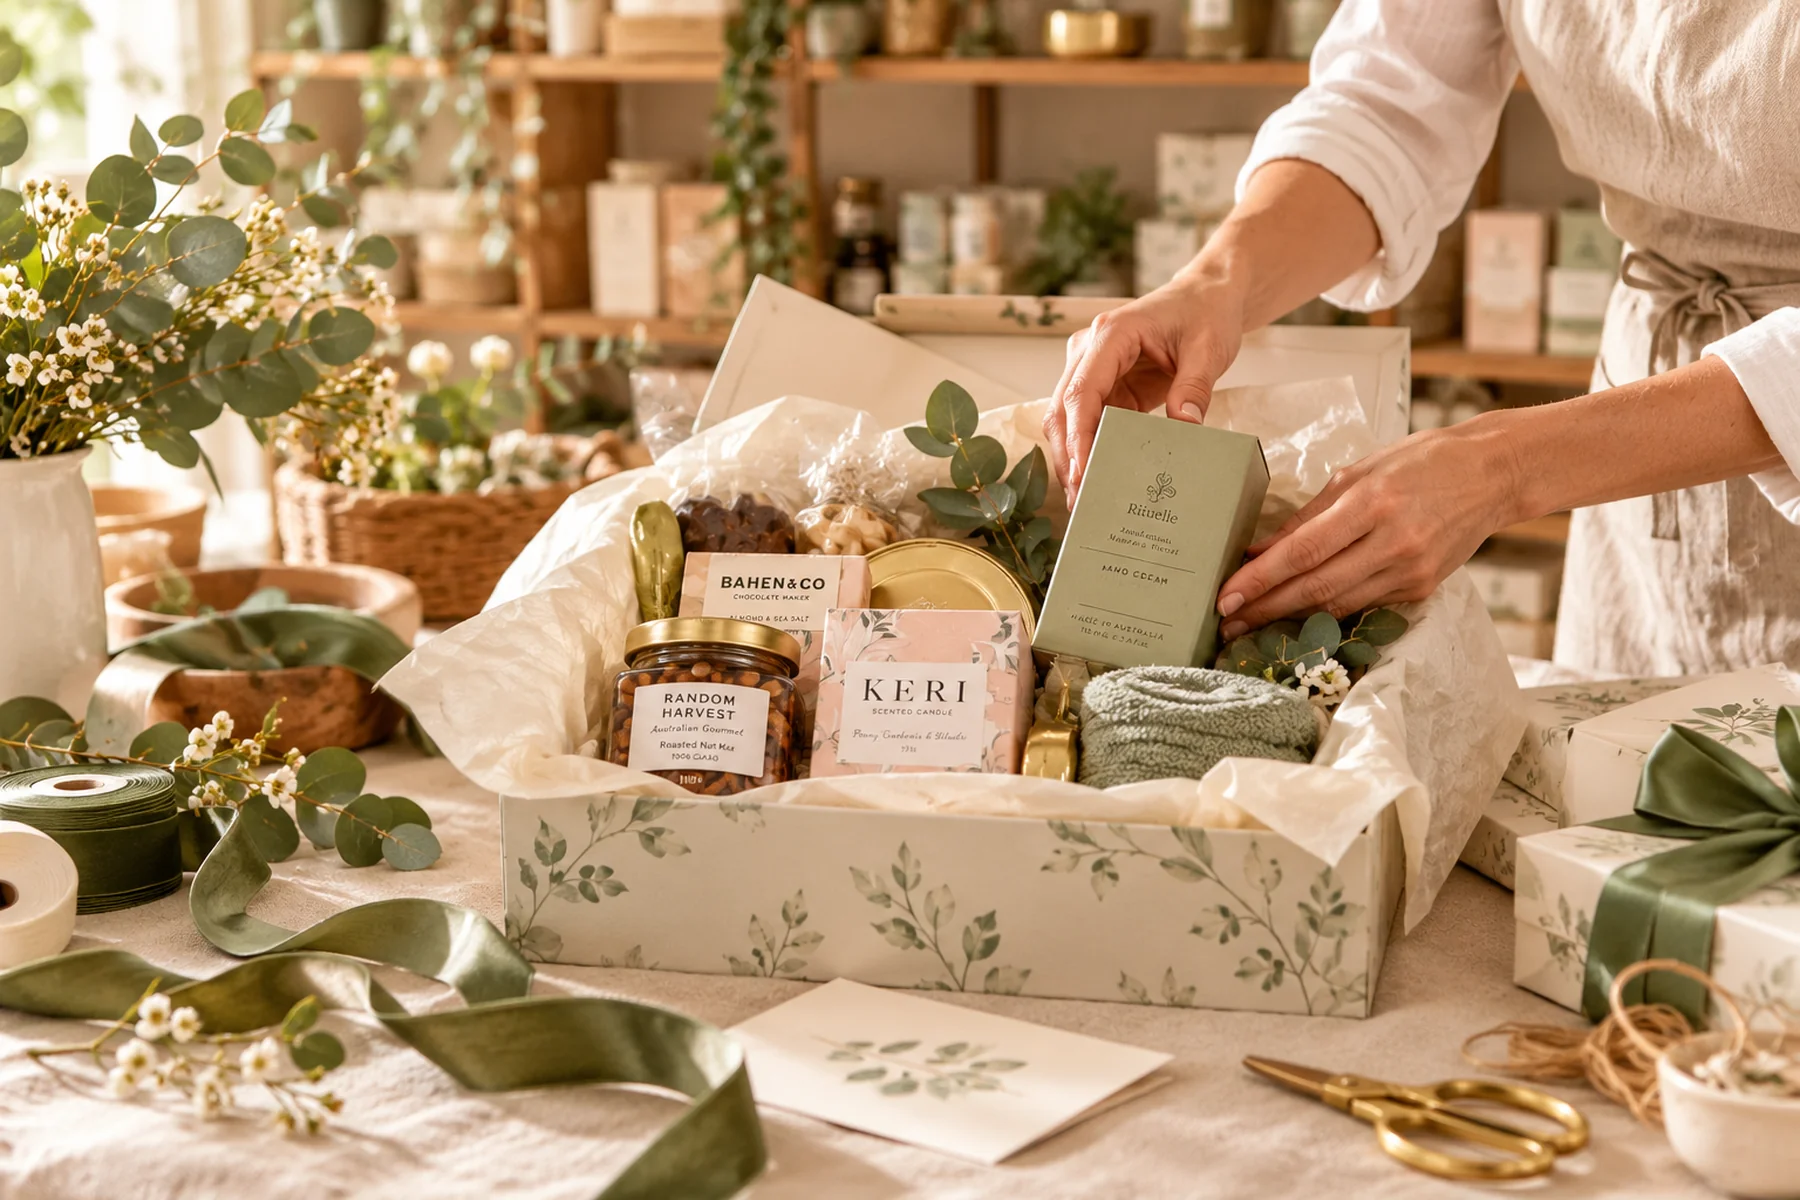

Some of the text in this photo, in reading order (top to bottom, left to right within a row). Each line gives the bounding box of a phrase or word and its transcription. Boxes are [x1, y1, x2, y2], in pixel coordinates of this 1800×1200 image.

[721, 576, 825, 590] BAHEN&CO
[862, 678, 967, 703] KERI
[664, 693, 736, 706] RANDOM
[662, 707, 736, 720] HARVEST
